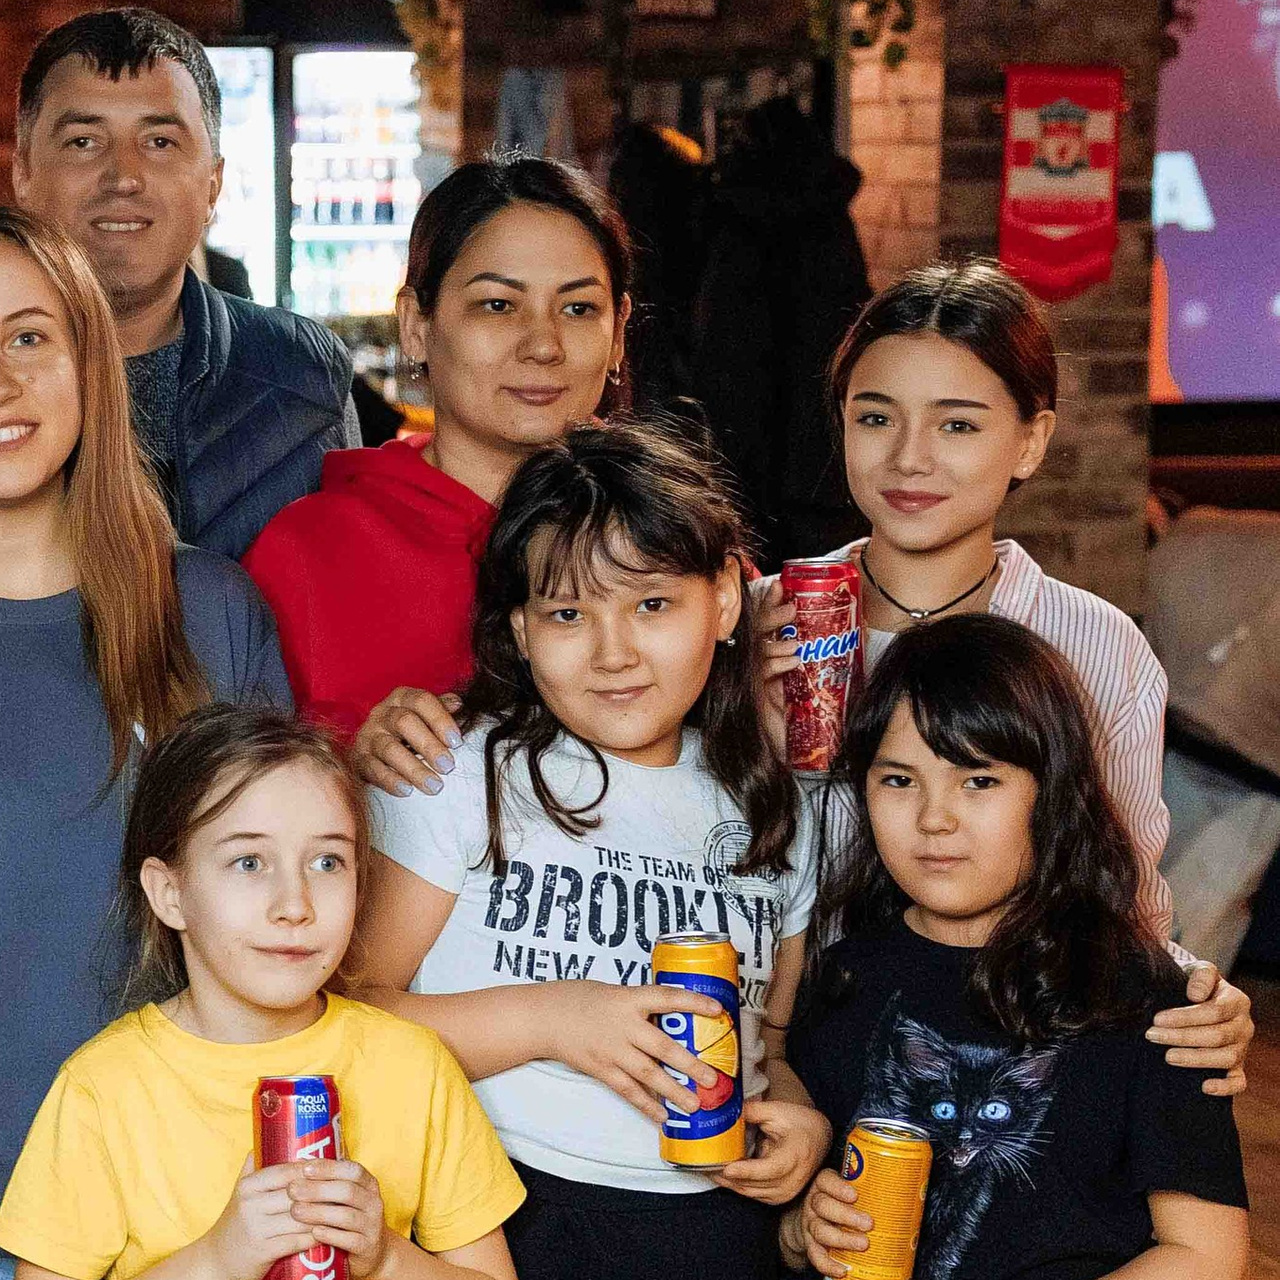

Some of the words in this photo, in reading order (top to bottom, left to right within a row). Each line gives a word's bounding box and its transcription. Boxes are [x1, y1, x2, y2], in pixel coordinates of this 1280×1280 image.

[595, 846, 632, 871] THE
[639, 855, 696, 883] TEAM
[493, 940, 596, 982] NEW
[298, 1104, 328, 1114] ROSSA
[299, 1094, 326, 1106] AQUA
